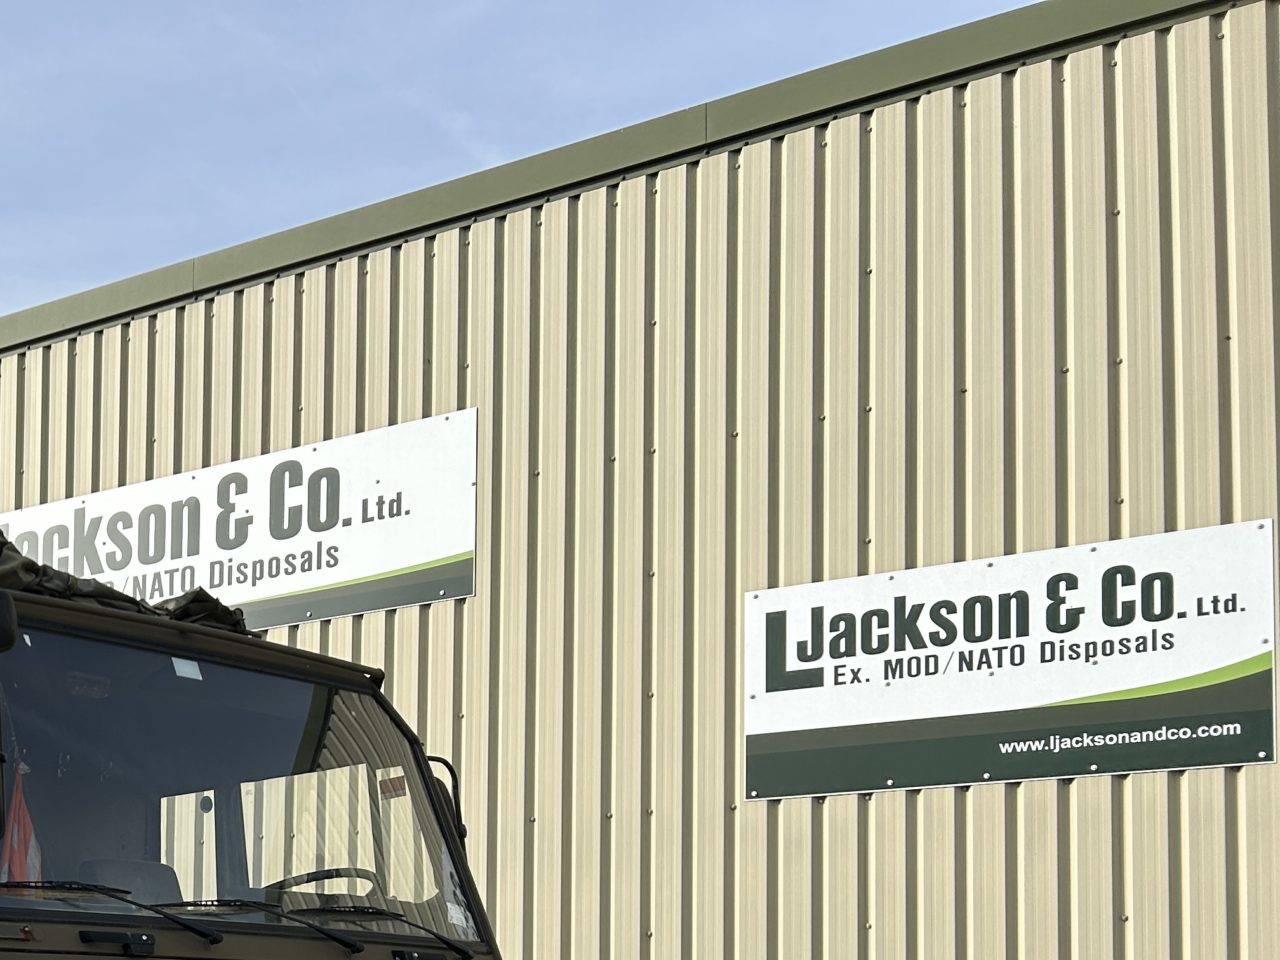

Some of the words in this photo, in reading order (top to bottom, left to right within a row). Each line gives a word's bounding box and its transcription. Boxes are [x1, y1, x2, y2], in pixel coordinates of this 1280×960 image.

[0, 494, 200, 580] ackson
[216, 472, 253, 551] &
[269, 459, 352, 541] Co.
[361, 492, 411, 523] Ltd.
[209, 541, 339, 590] Disposals
[1045, 572, 1085, 633] &
[1101, 564, 1188, 624] Co.
[1196, 593, 1246, 617] Ltd.
[833, 664, 870, 686] Ex.
[884, 645, 1025, 681] MOD/NATO
[1040, 630, 1175, 662] Disposals
[999, 721, 1242, 754] www.ljacksonandco.com
